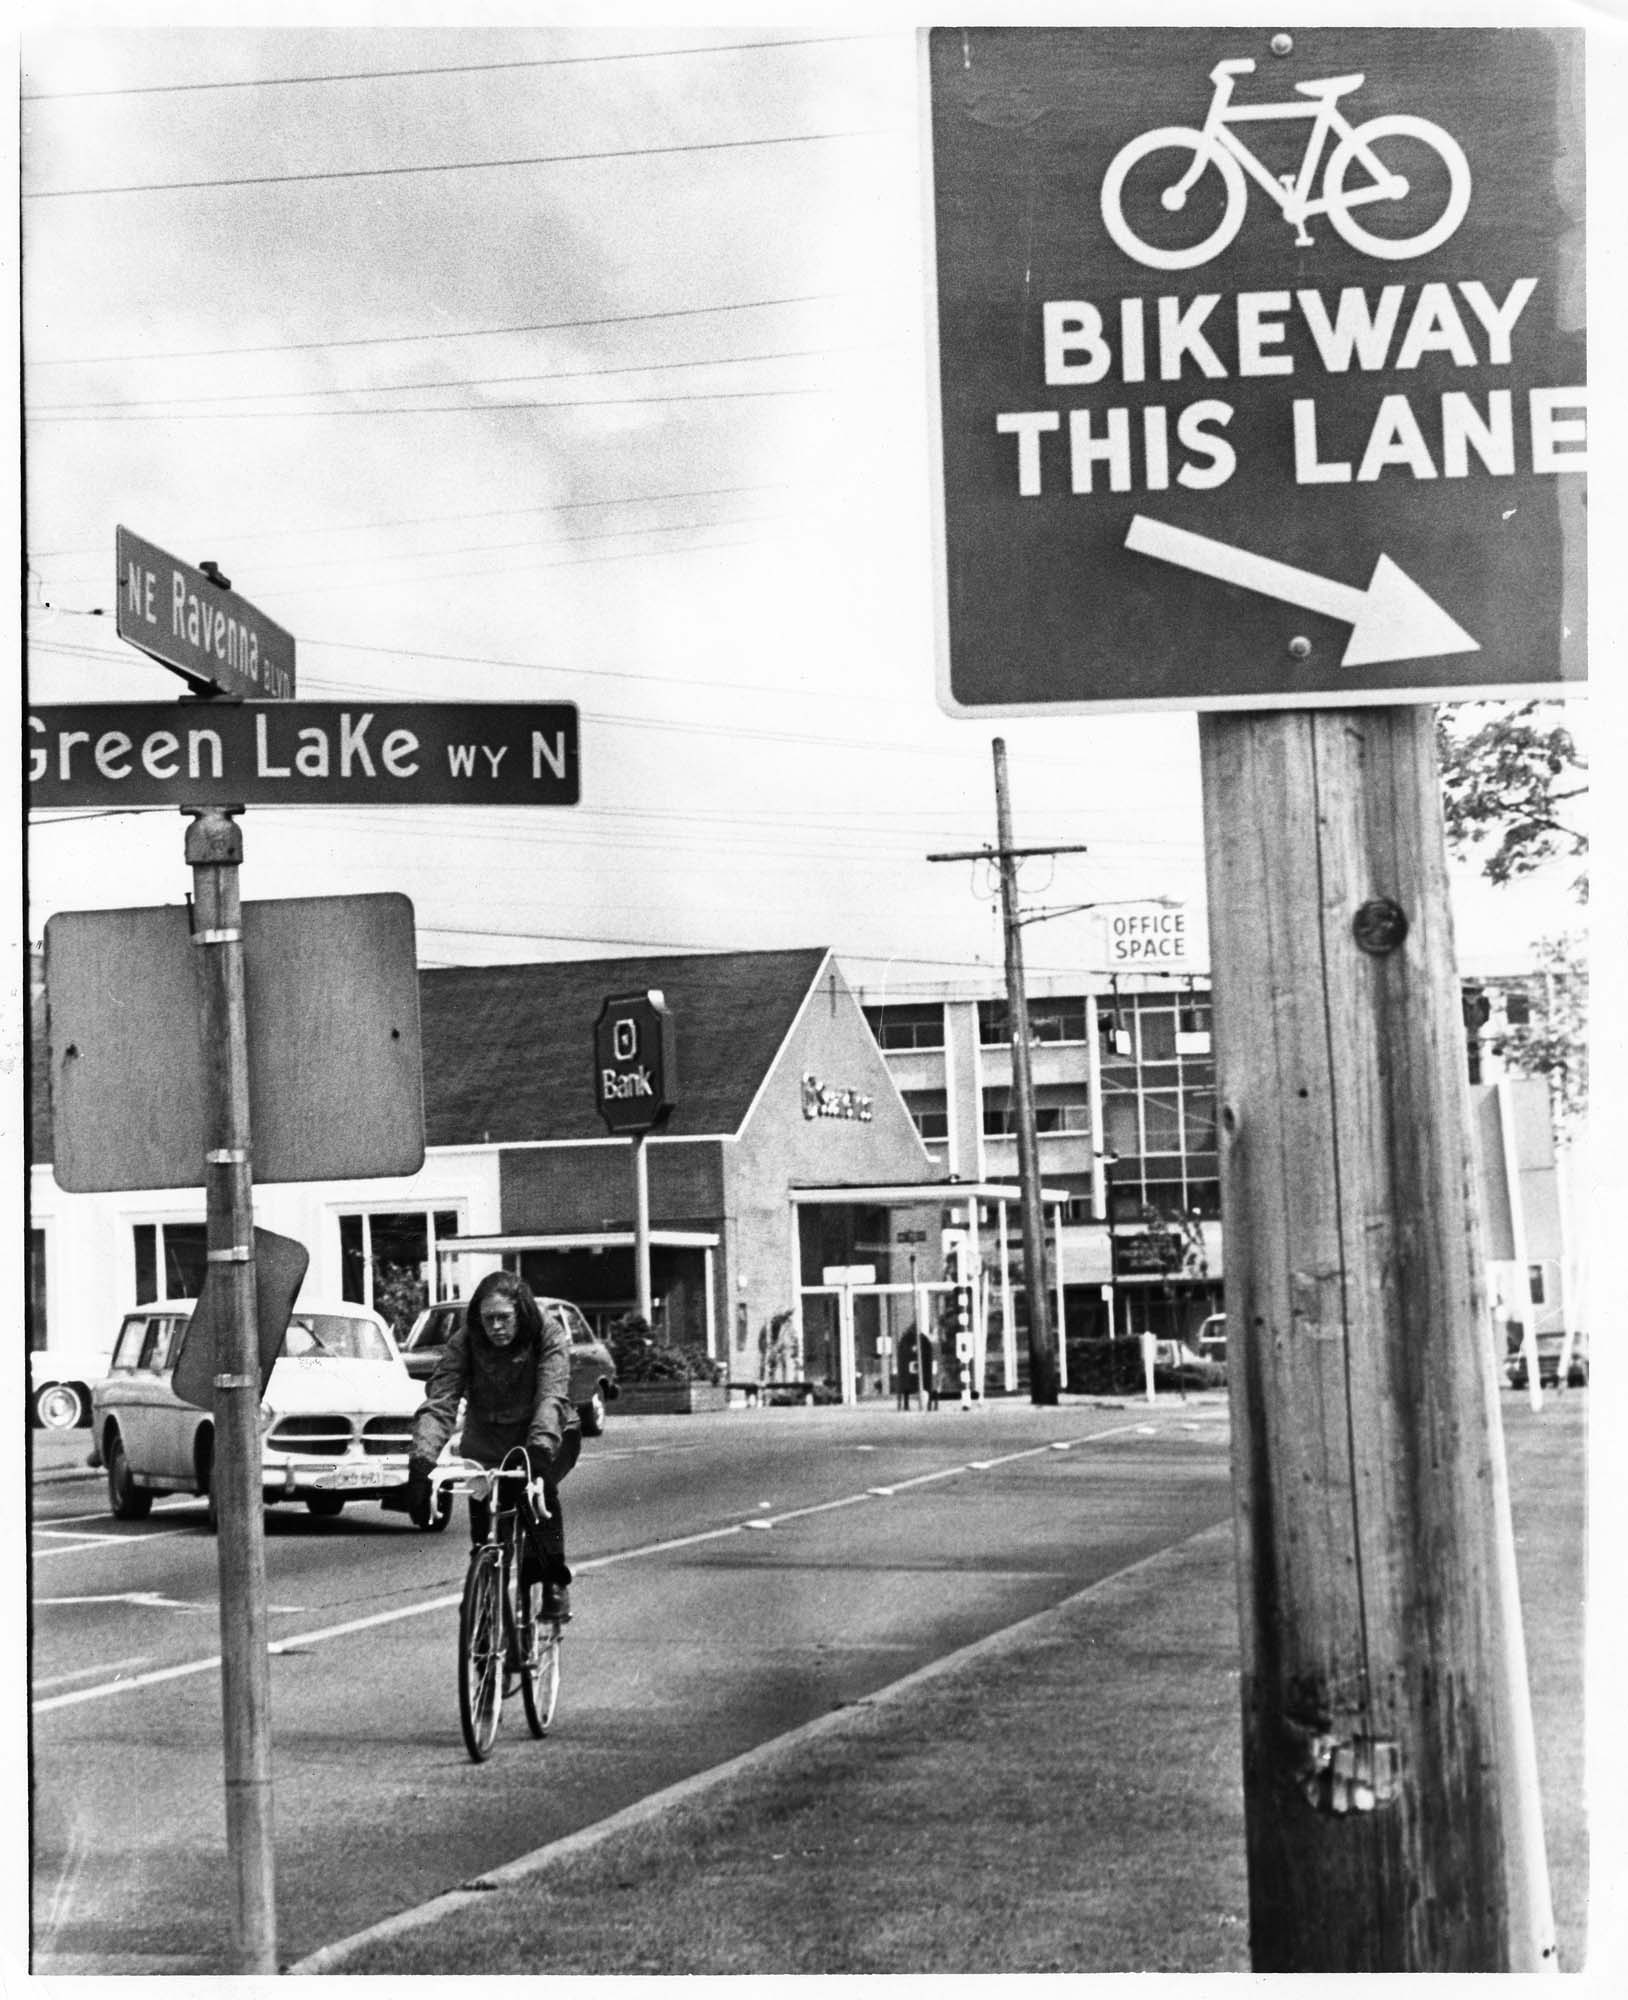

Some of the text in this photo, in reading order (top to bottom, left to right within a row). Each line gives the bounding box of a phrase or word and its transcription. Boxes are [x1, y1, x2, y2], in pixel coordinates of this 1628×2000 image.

[1043, 278, 1538, 386] BIKEWAY
[996, 386, 1588, 496] THIS LANE
[128, 561, 157, 625] NE
[172, 570, 259, 682] Ravenna
[532, 731, 567, 778] N
[1113, 914, 1185, 936] OFFICE
[1114, 937, 1185, 959] SPACE
[602, 1065, 653, 1099] Bank
